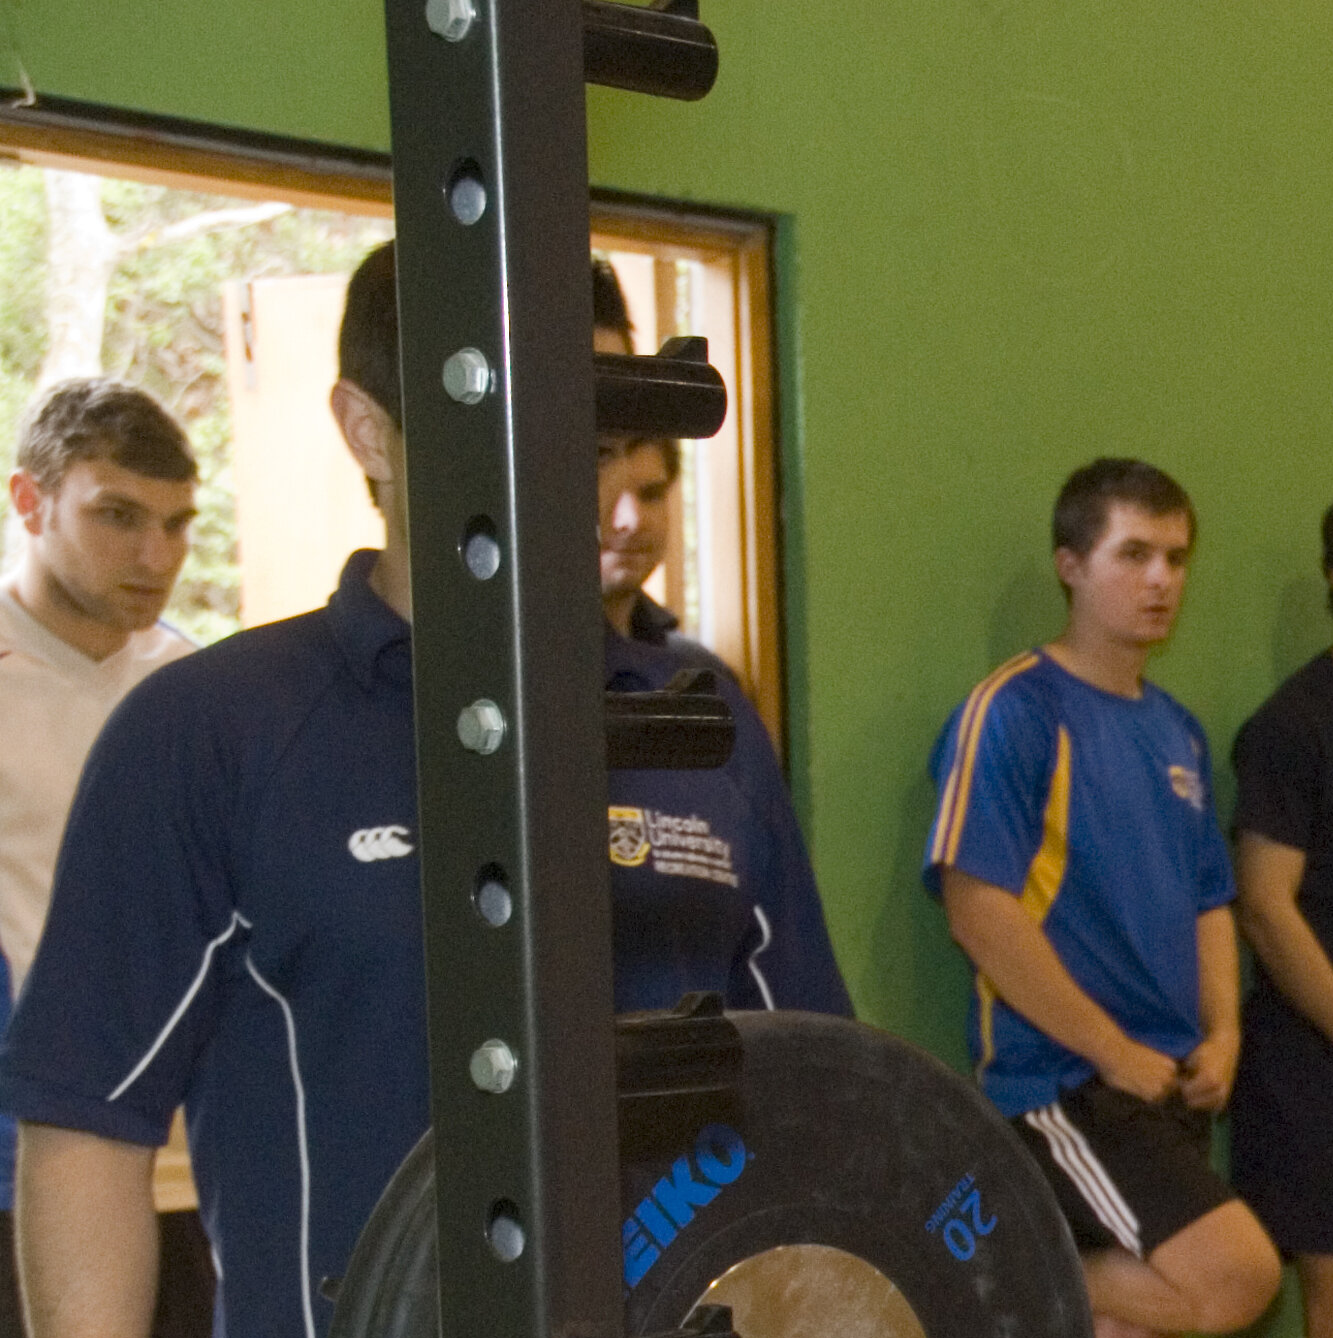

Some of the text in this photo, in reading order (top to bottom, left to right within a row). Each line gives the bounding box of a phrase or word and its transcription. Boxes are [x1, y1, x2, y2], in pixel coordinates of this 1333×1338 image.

[644, 809, 709, 834] Lincoln
[649, 824, 731, 862] University
[944, 1189, 998, 1261] 20
